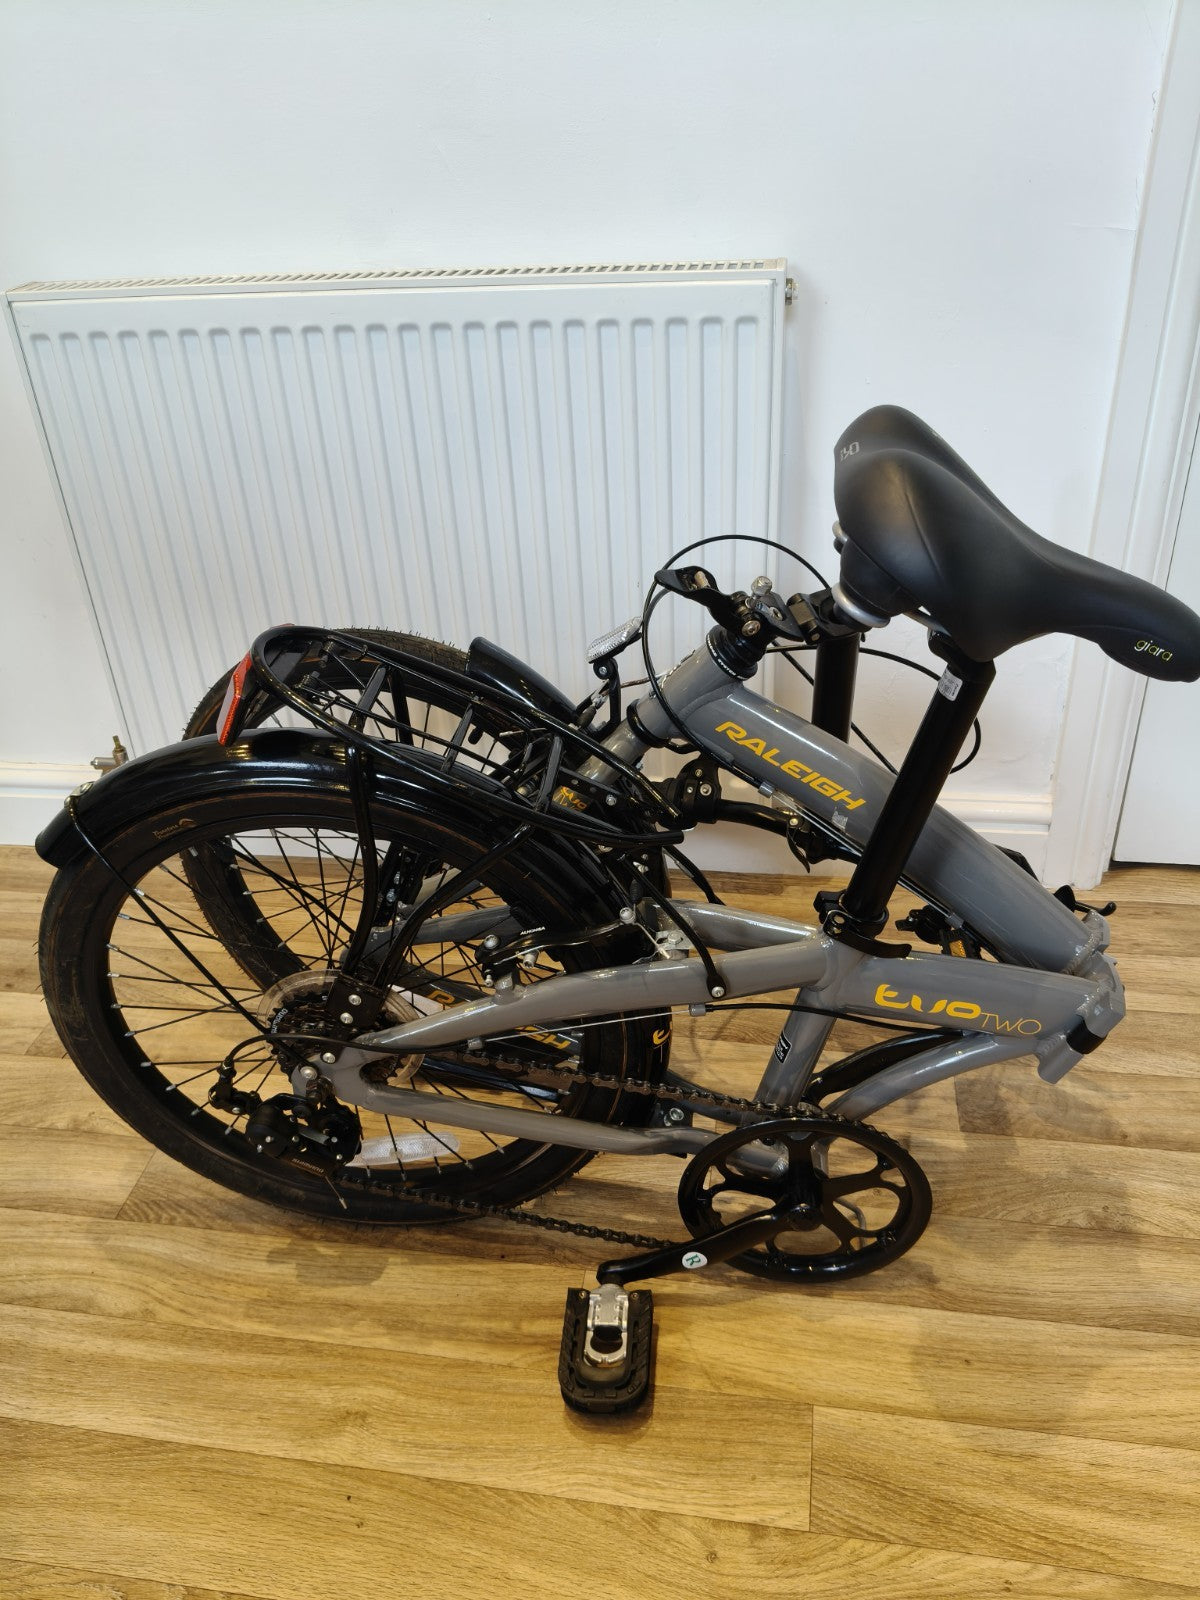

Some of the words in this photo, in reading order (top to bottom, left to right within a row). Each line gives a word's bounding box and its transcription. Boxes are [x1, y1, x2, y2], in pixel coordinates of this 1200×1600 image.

[1133, 639, 1173, 661] giara
[714, 721, 867, 810] RALEIGH
[981, 1012, 1042, 1035] TWO
